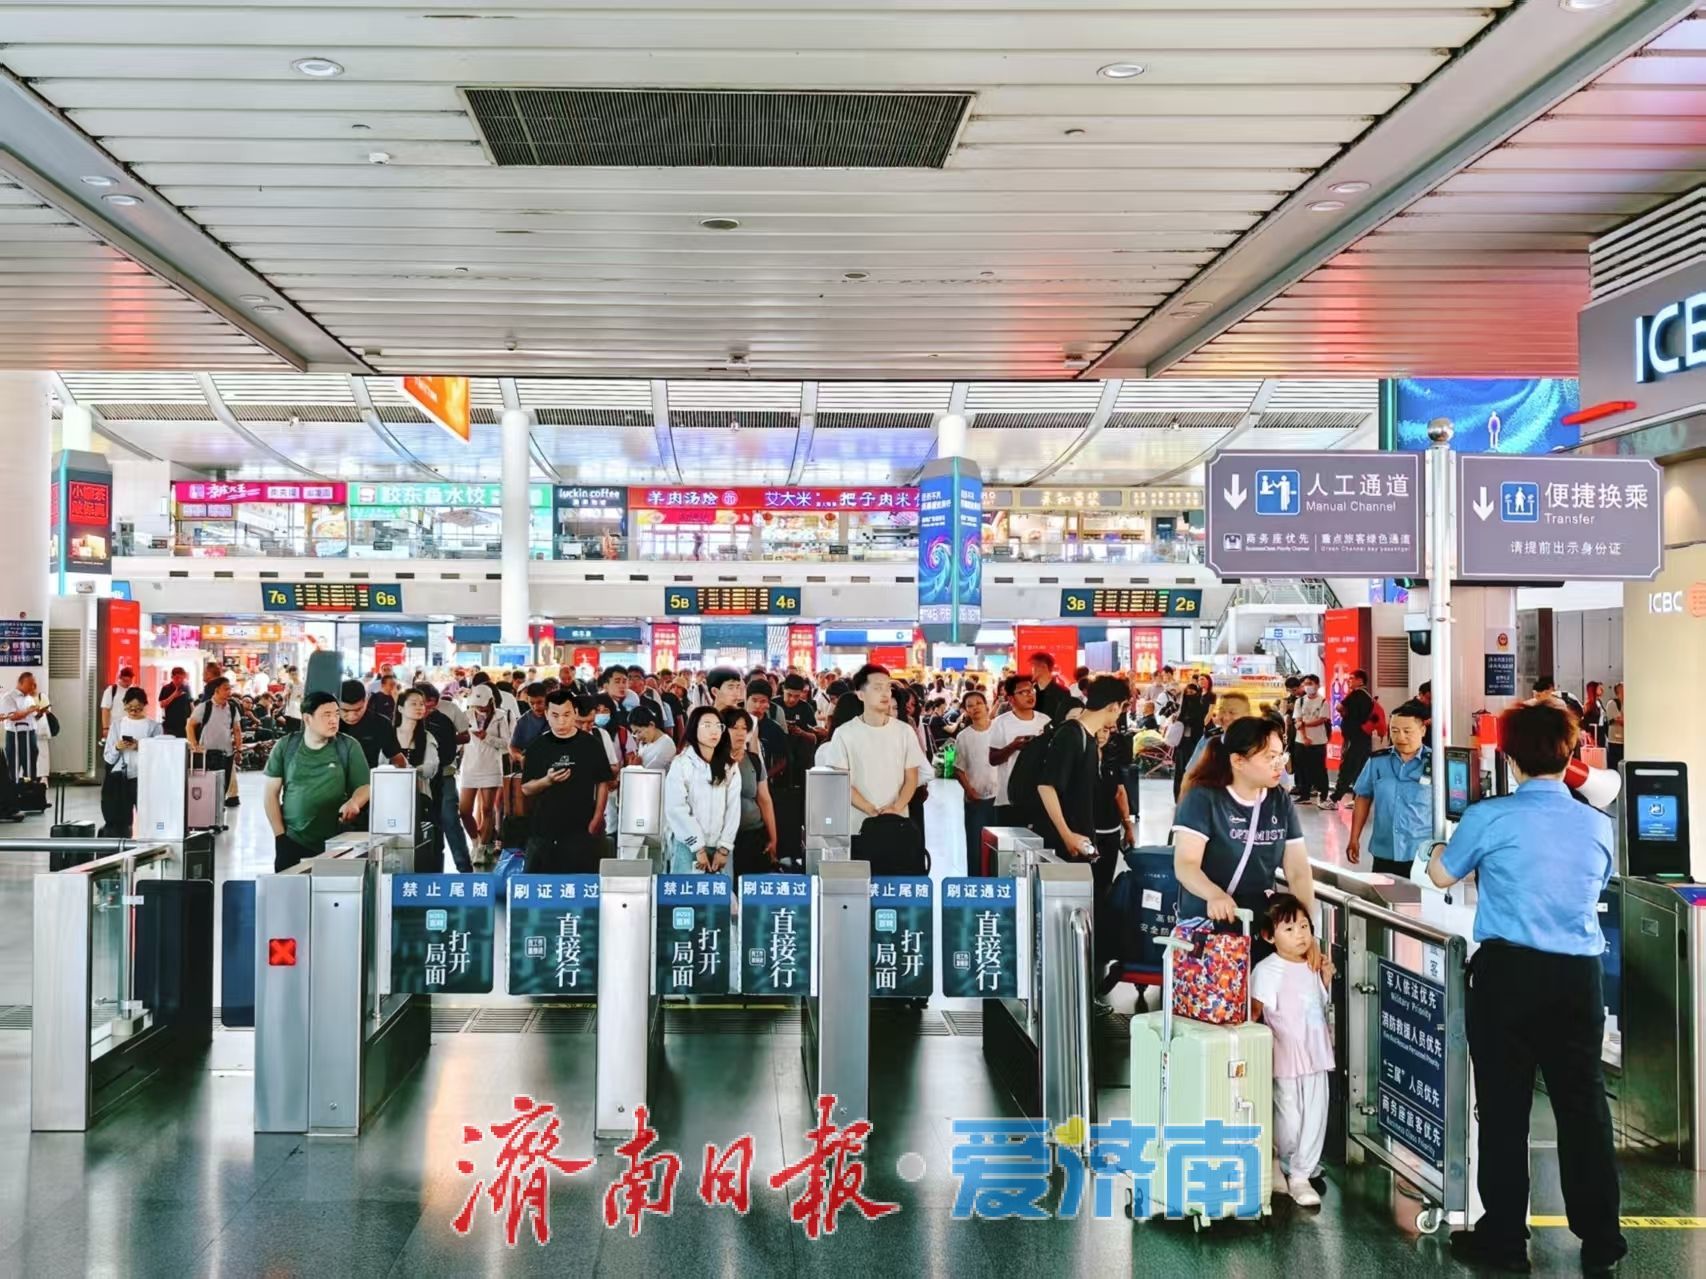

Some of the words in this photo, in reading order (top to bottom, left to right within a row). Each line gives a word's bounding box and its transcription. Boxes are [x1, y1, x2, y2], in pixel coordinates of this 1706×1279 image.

[1306, 473, 1410, 498] 人工通道
[558, 488, 588, 500] luckin
[588, 488, 620, 500] coffee
[765, 491, 812, 507] 艾大米
[1544, 482, 1649, 509] 便捷换乘
[1306, 501, 1347, 512] Manual
[1350, 501, 1396, 512] Channel
[1544, 513, 1596, 524] Transfer
[1245, 533, 1310, 544] 商务座优先
[1321, 533, 1411, 545] 重点旅客绿色通道
[1511, 541, 1622, 556] 请提前出示身份证
[268, 590, 287, 605] 7B
[375, 591, 397, 606] 6B
[670, 595, 689, 609] 5B
[775, 595, 796, 608] 4B
[1066, 596, 1086, 611] 3B
[1174, 596, 1196, 611] 2B
[1648, 590, 1683, 614] ICBC
[1229, 827, 1287, 841] OPTMIST
[402, 881, 489, 897] 禁止尾随
[513, 883, 600, 899] 刷证通过
[663, 881, 727, 896] 禁止尾随
[743, 881, 807, 896] 刷证通过
[947, 884, 1012, 898] 刷证通过
[448, 930, 471, 974] 打开
[555, 912, 581, 988] 直接行
[698, 928, 721, 975] 打开
[770, 908, 797, 988] 直接行
[901, 929, 924, 977] 打开
[975, 910, 1002, 991] 直接行
[425, 943, 447, 985] 局面
[672, 941, 694, 988] 局面
[875, 943, 898, 990] 局面
[1386, 970, 1437, 1009] 军人依法优先
[1382, 1010, 1442, 1058] 消防救援人员优先
[1382, 1094, 1441, 1147] 商务座旅客优先
